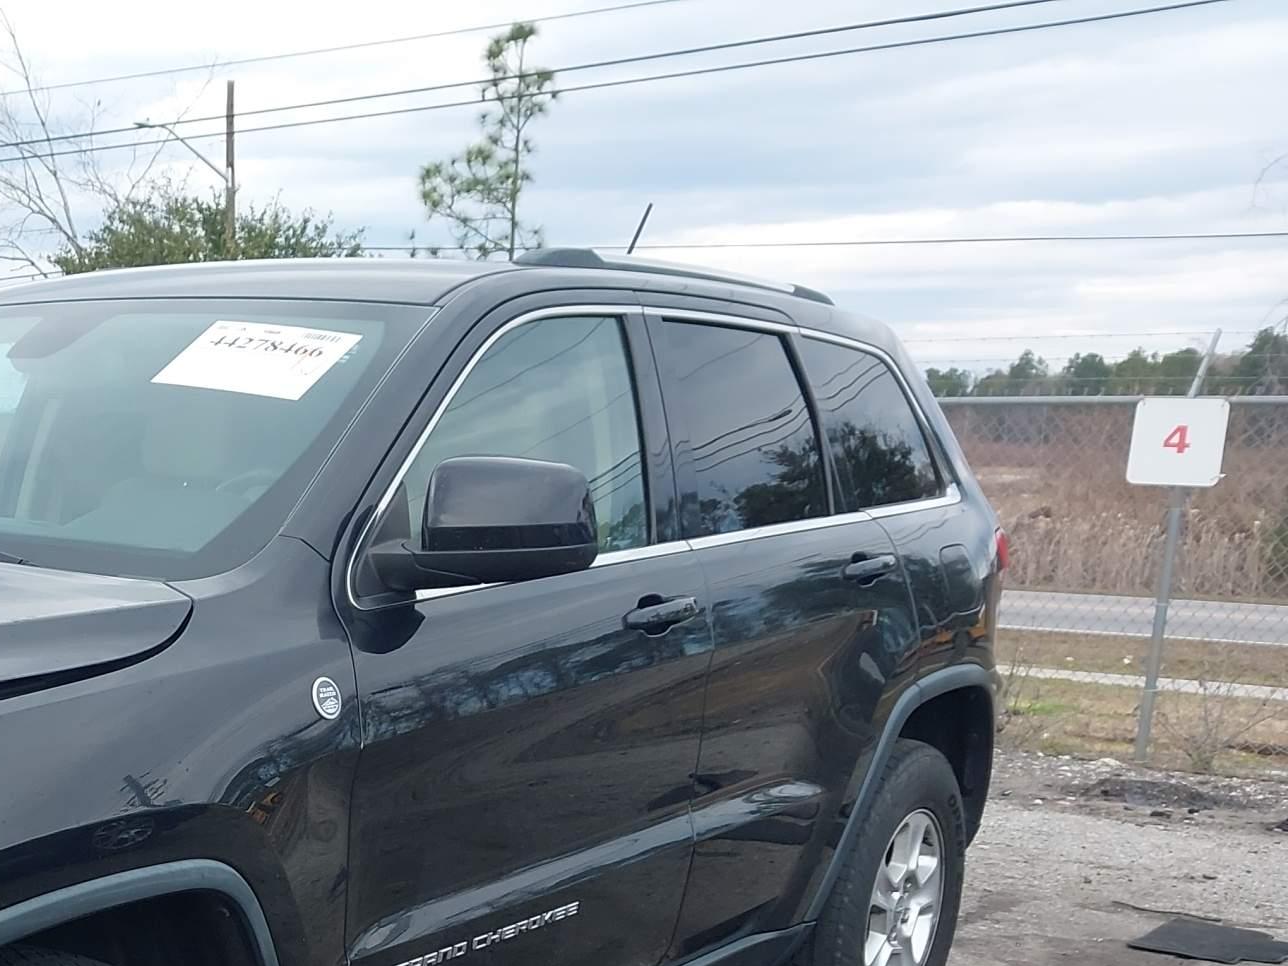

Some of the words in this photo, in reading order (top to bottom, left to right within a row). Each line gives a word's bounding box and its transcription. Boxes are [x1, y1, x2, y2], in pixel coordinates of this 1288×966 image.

[210, 335, 324, 358] 44278466
[1162, 425, 1191, 453] 4
[472, 901, 580, 950] CHEROKEE
